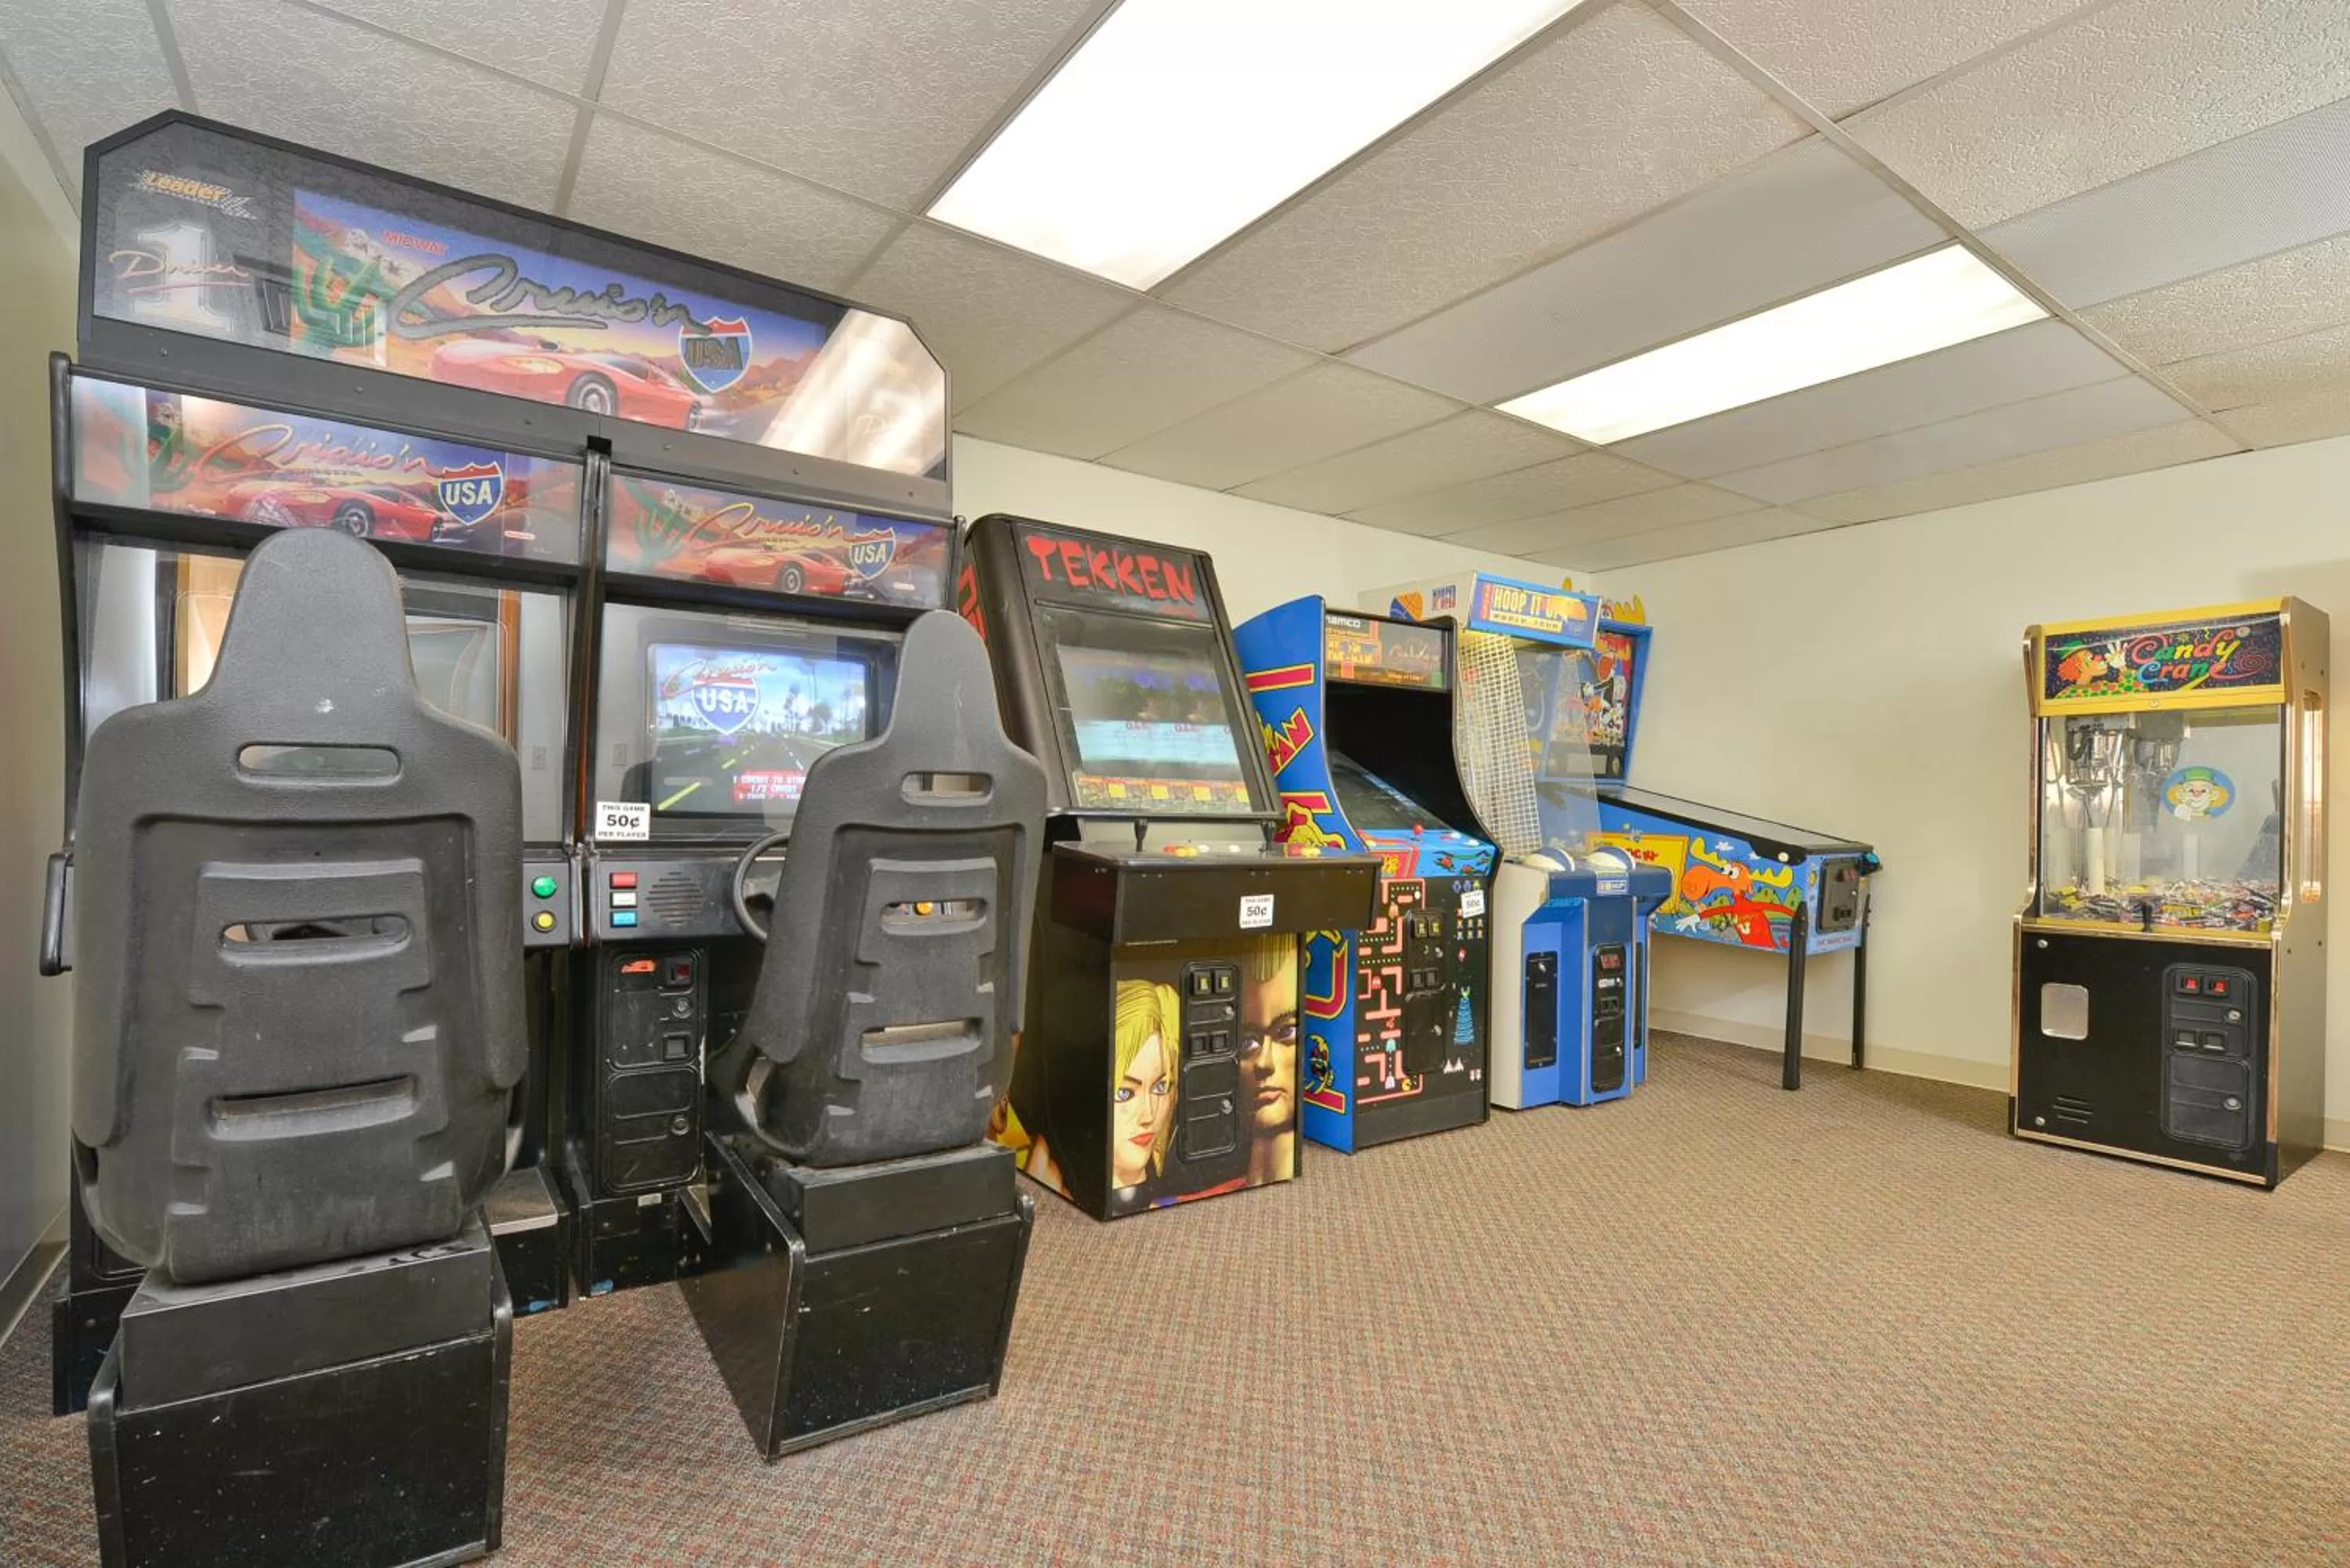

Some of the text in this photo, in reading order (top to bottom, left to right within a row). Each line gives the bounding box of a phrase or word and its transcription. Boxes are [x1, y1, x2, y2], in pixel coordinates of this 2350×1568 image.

[146, 171, 227, 202] Leader
[683, 337, 744, 370] USA
[445, 482, 494, 506] USA
[854, 544, 887, 565] USA
[1027, 535, 1196, 605] TEKKEN
[1493, 587, 1527, 613] HOOP
[1530, 594, 1543, 616] IT
[2126, 629, 2241, 667] Candy
[2137, 660, 2254, 683] Crane
[701, 688, 749, 714] USA
[607, 814, 640, 830] 50¢
[1246, 905, 1267, 917] 50¢
